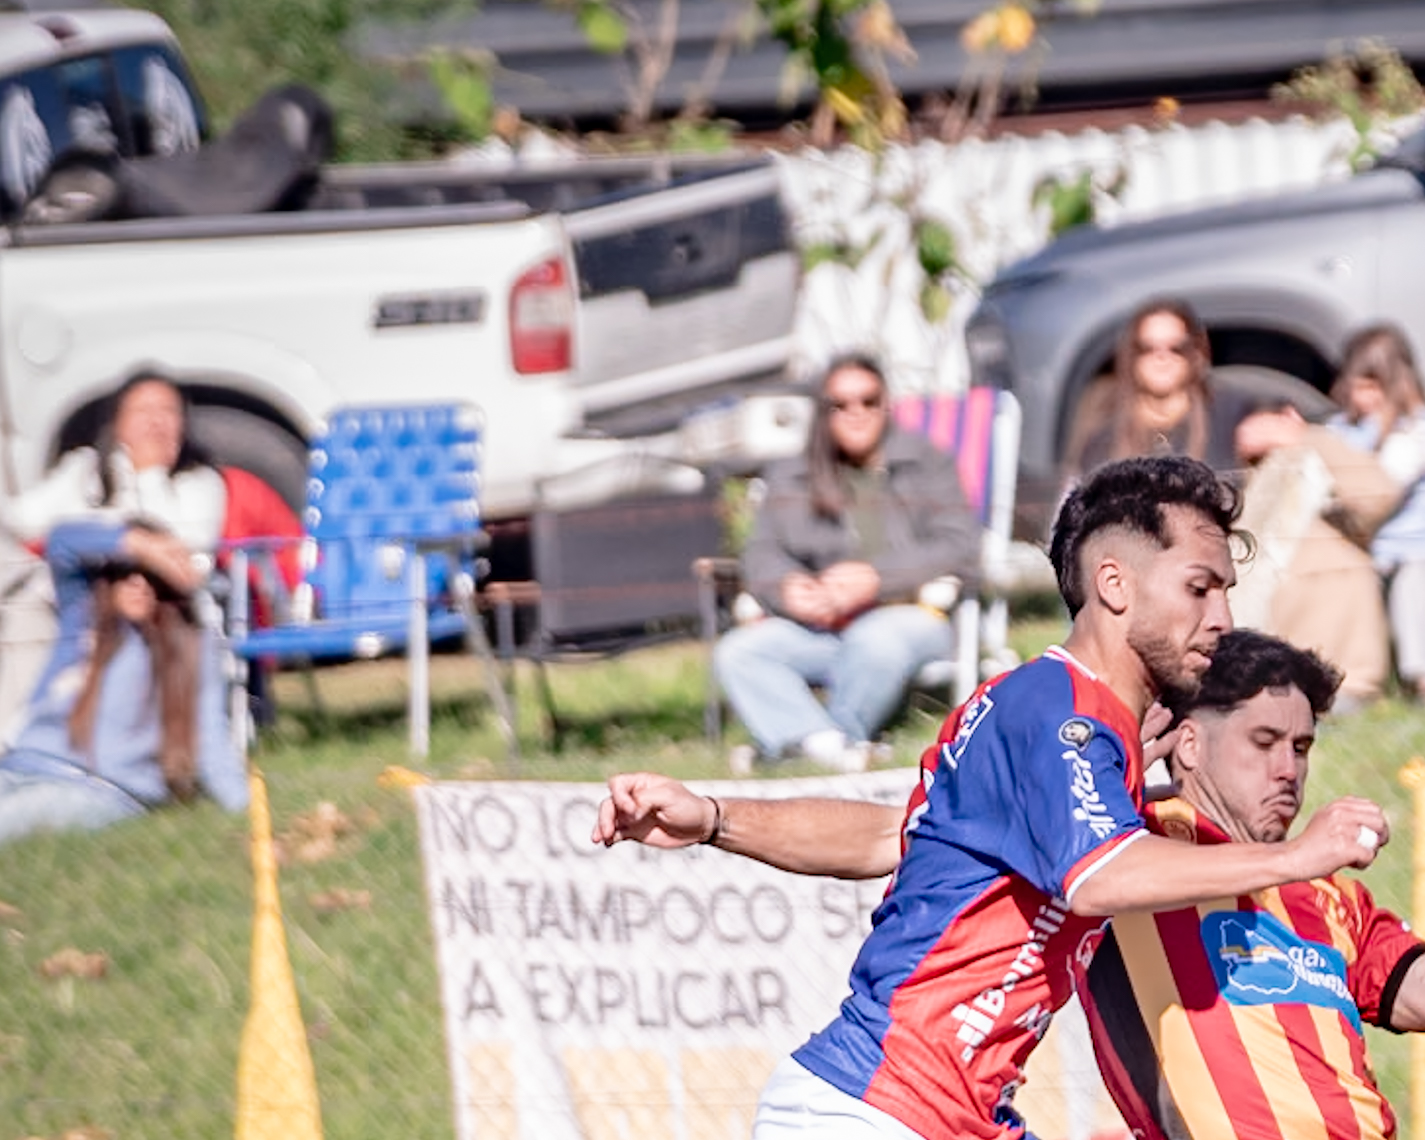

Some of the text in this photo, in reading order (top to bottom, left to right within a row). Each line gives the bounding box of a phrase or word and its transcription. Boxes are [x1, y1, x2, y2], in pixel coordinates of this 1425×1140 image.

[431, 797, 518, 853] NO
[442, 876, 494, 937] NI
[507, 880, 794, 944] TAMPOCO
[463, 961, 792, 1030] A EXPLICAR
